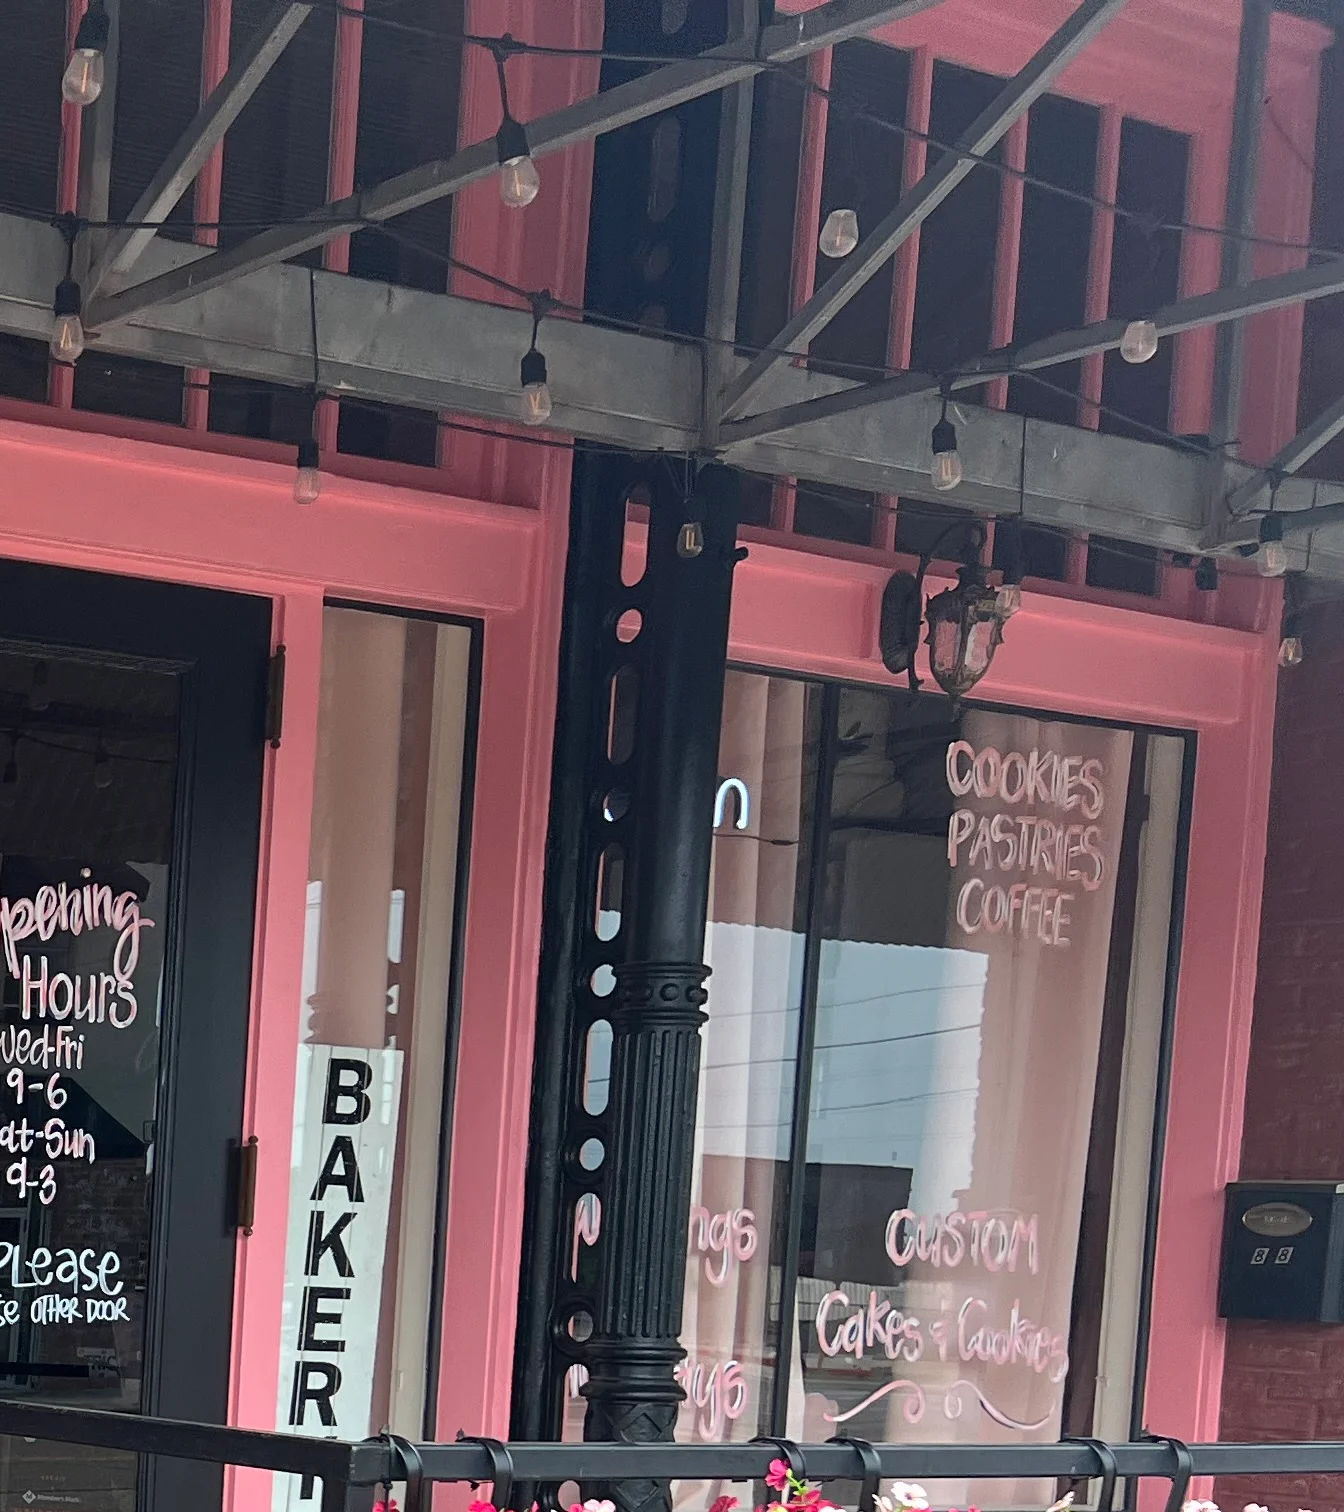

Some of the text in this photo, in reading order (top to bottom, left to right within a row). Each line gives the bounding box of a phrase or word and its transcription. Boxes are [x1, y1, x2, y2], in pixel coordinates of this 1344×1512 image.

[946, 740, 1104, 819] COOKIES
[947, 809, 1104, 891] PASTRIES
[956, 878, 1074, 946] COFFEE
[21, 954, 137, 1028] Hours
[289, 1057, 372, 1500] BAKER
[816, 1290, 923, 1362] Cakes
